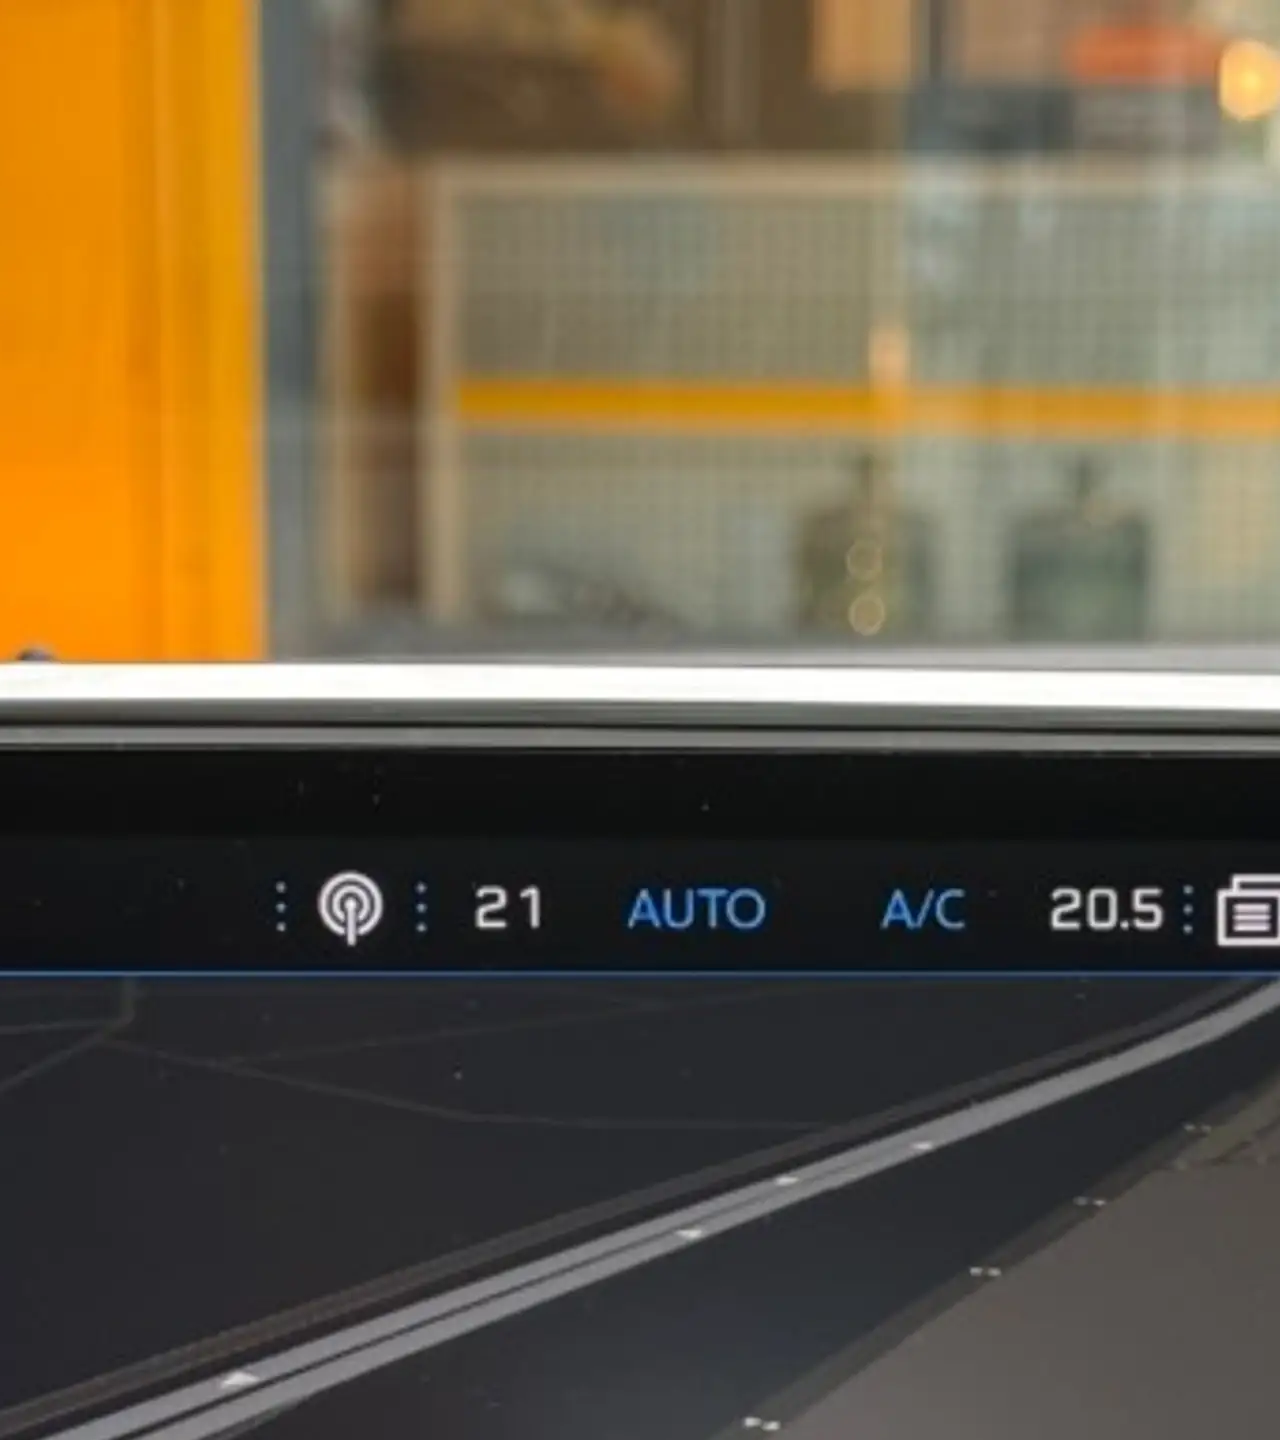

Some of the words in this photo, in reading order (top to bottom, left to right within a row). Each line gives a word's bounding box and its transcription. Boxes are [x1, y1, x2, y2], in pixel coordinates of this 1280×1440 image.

[475, 885, 546, 929] 21
[627, 886, 766, 930] AUTO
[881, 887, 965, 930] A/C
[1050, 886, 1164, 930] 20.5
